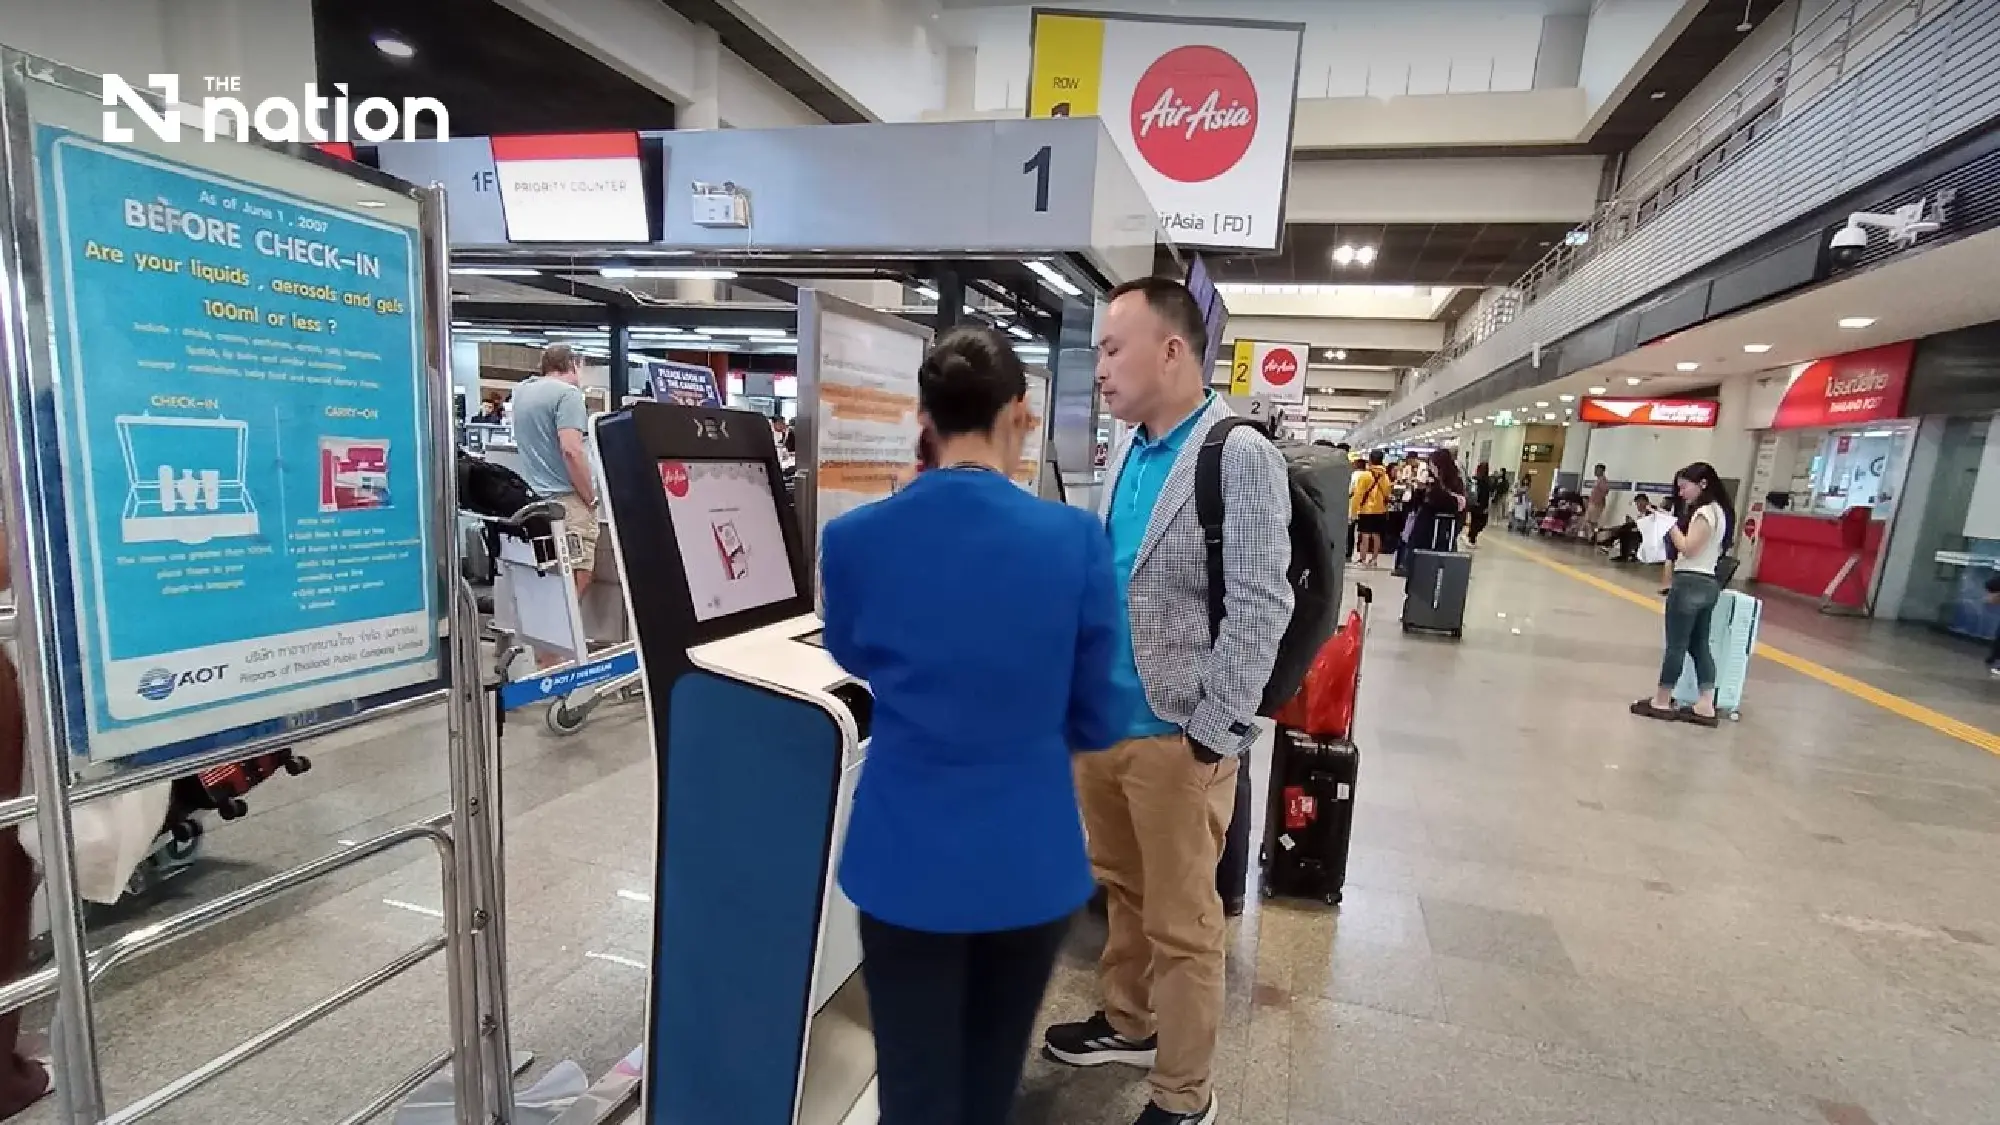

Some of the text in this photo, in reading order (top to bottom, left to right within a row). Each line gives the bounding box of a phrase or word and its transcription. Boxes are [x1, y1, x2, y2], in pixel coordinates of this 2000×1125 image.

[1053, 77, 1080, 89] ROW
[472, 171, 493, 192] 1F
[514, 180, 627, 192] PRIORITY COUNTER
[1023, 145, 1051, 212] 1
[200, 191, 217, 206] As
[222, 197, 236, 210] of
[242, 202, 272, 220] June
[277, 210, 284, 223] 1
[297, 215, 329, 233] 2007
[1159, 212, 1205, 230] irAsia
[124, 198, 381, 279] BEFORE CHECK-IN
[86, 240, 124, 264] Are
[134, 252, 182, 273] your
[191, 258, 250, 286] liquids
[271, 279, 338, 301] aerosols
[343, 292, 372, 308] and
[376, 298, 404, 315] gels
[204, 299, 338, 335] 100ml or less ?
[1236, 362, 1249, 383] 2
[151, 395, 219, 409] CHECK-IN
[1250, 401, 1261, 415] 2
[325, 406, 378, 420] CARRY-ON
[178, 663, 230, 687] AOT
